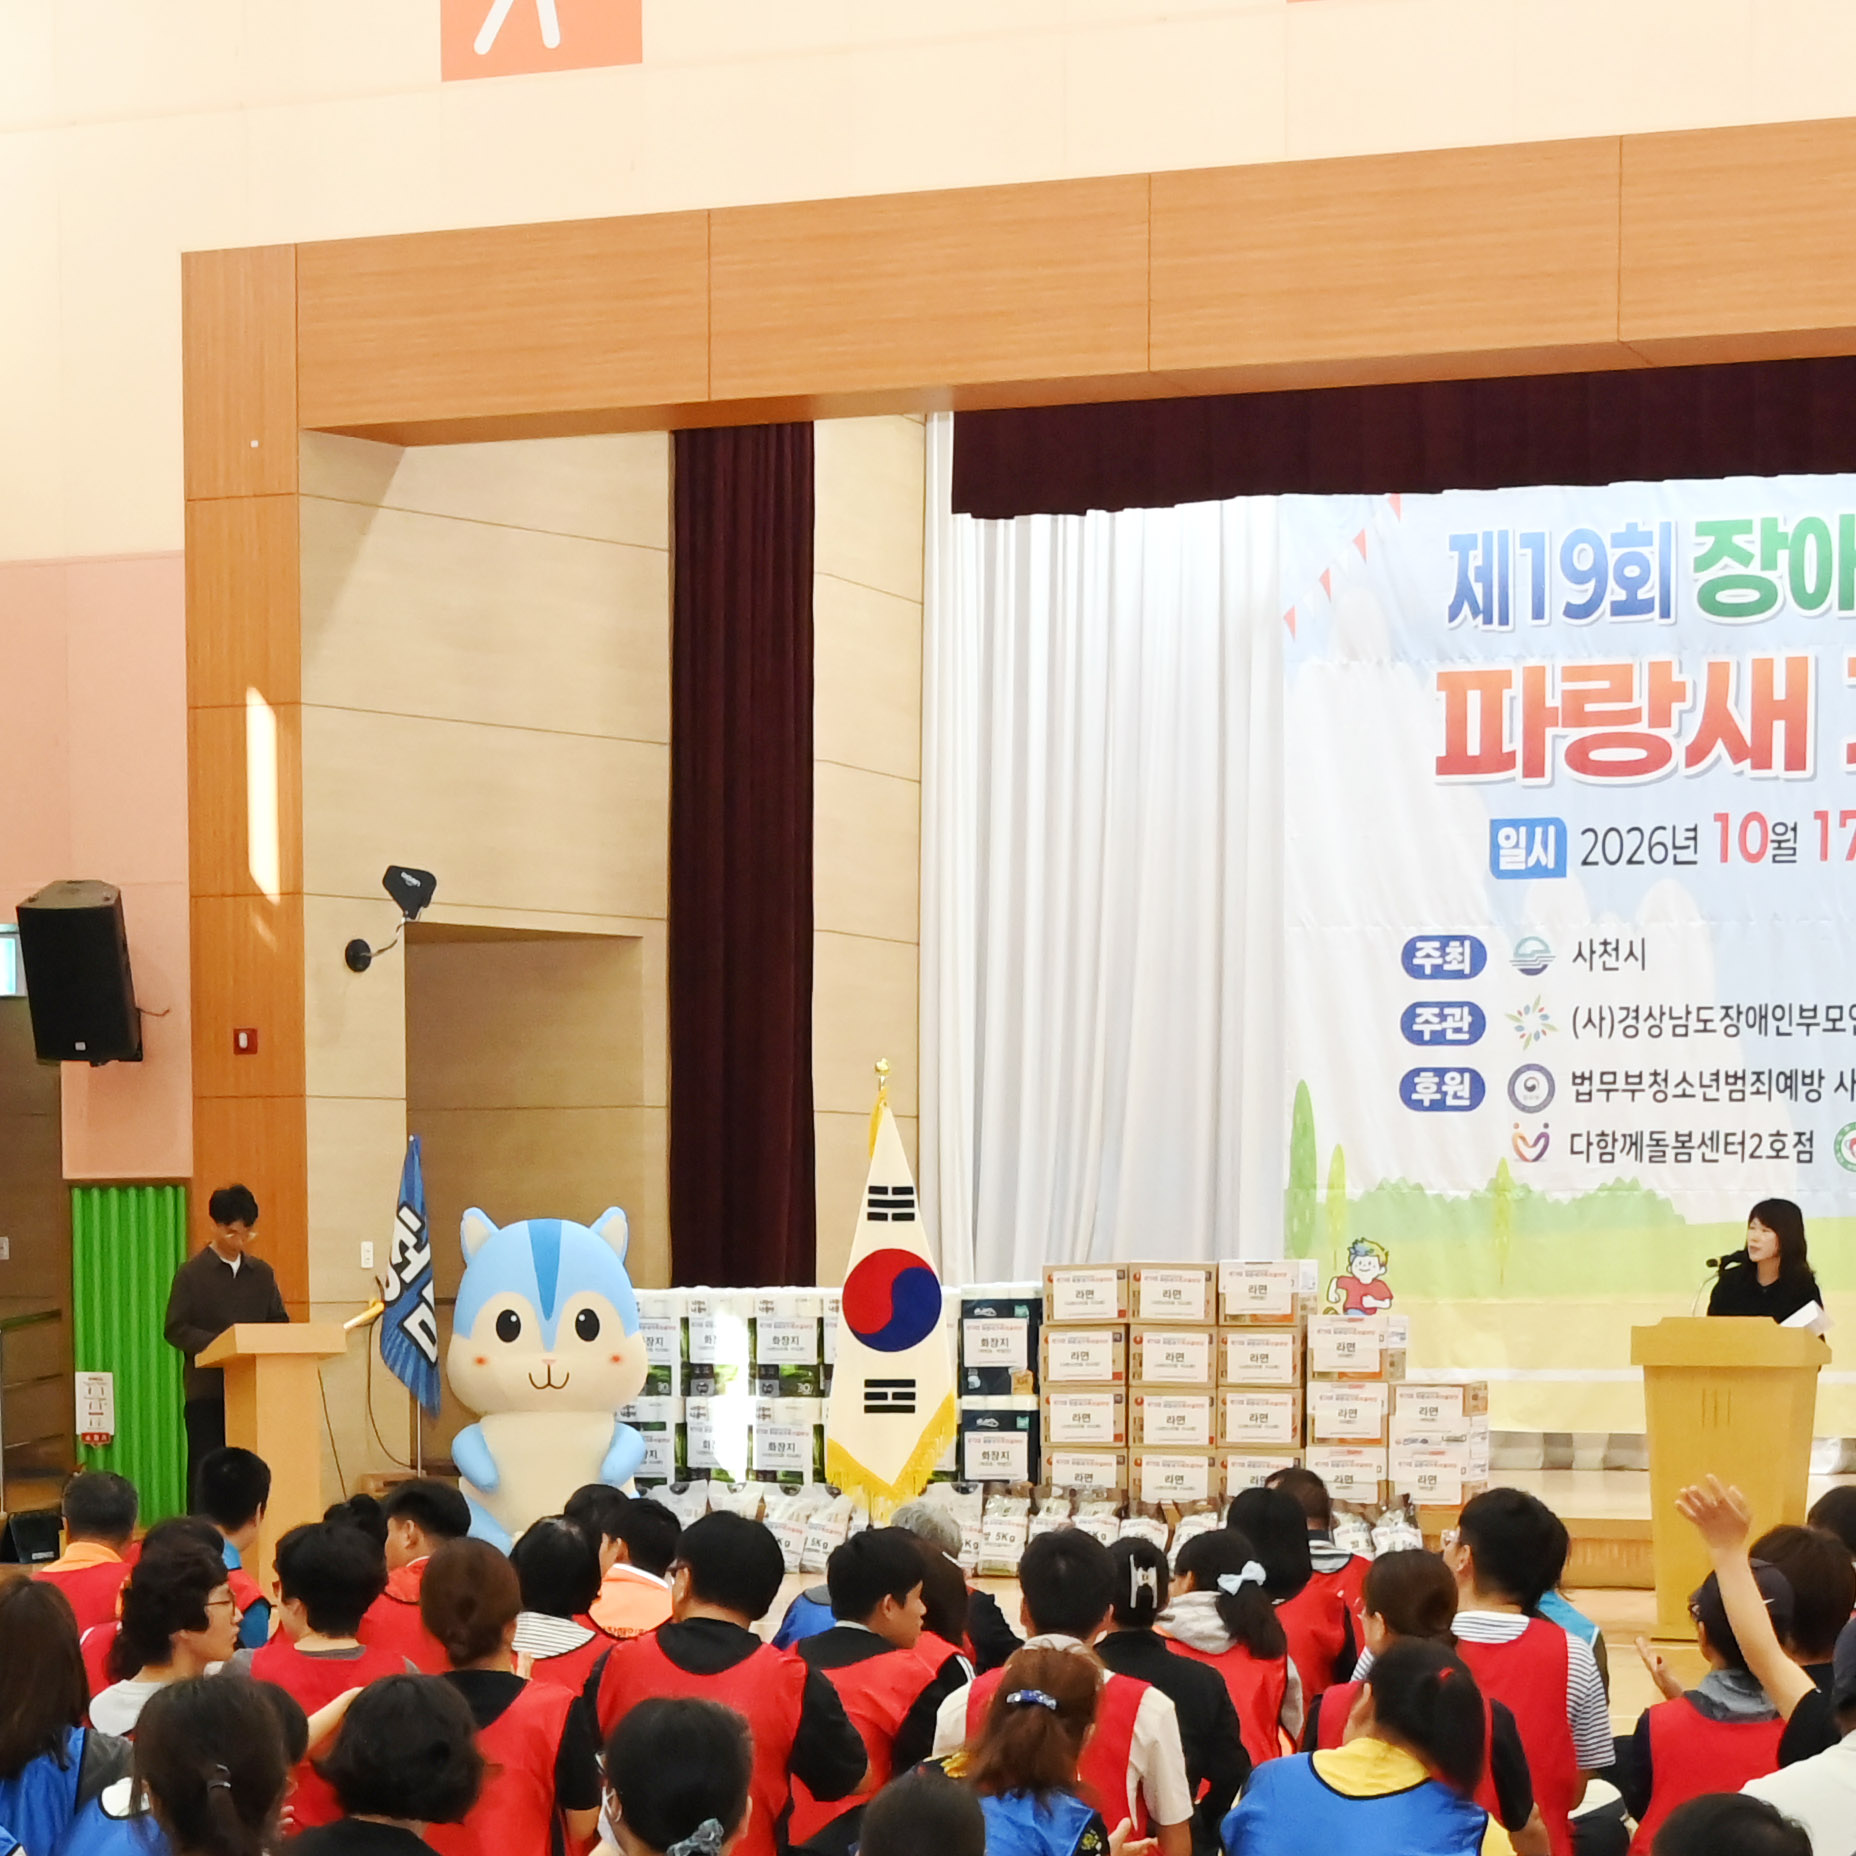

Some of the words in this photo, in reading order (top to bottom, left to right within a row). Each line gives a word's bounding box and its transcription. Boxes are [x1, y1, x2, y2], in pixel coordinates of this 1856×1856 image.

[1448, 521, 1672, 626] 제19회
[1436, 656, 1810, 780] 파랑새
[1497, 825, 1556, 870] 일시
[1580, 820, 1698, 867] 2026년
[1713, 811, 1800, 864] 10월
[1413, 941, 1470, 975] 주최
[1572, 939, 1645, 973] 사천시
[1413, 1006, 1471, 1040] 주관
[1411, 1073, 1470, 1107] 후원
[1572, 1069, 1824, 1104] 법무부청소년범죄예방
[1569, 1129, 1814, 1164] 다함께돌봄센터2호점
[1076, 1290, 1094, 1299] 라면
[1163, 1290, 1181, 1299] 라면
[1248, 1285, 1267, 1295] 라면
[773, 1336, 799, 1345] 화장지
[981, 1338, 1008, 1347] 화장지
[1337, 1342, 1355, 1352] 라면
[1071, 1351, 1089, 1361] 라면
[1166, 1353, 1184, 1362] 라면
[1250, 1354, 1269, 1363] 라면
[1338, 1409, 1357, 1418] 라면
[1419, 1407, 1438, 1416] 라면
[1072, 1413, 1090, 1423] 라면
[1167, 1416, 1185, 1425] 라면
[1249, 1413, 1268, 1423] 라면
[768, 1443, 796, 1453] 화장지
[982, 1451, 1009, 1460] 화장지
[1075, 1473, 1093, 1483] 라면
[1165, 1475, 1184, 1485] 라면
[1333, 1475, 1355, 1484] 라면
[1418, 1475, 1437, 1485] 라면
